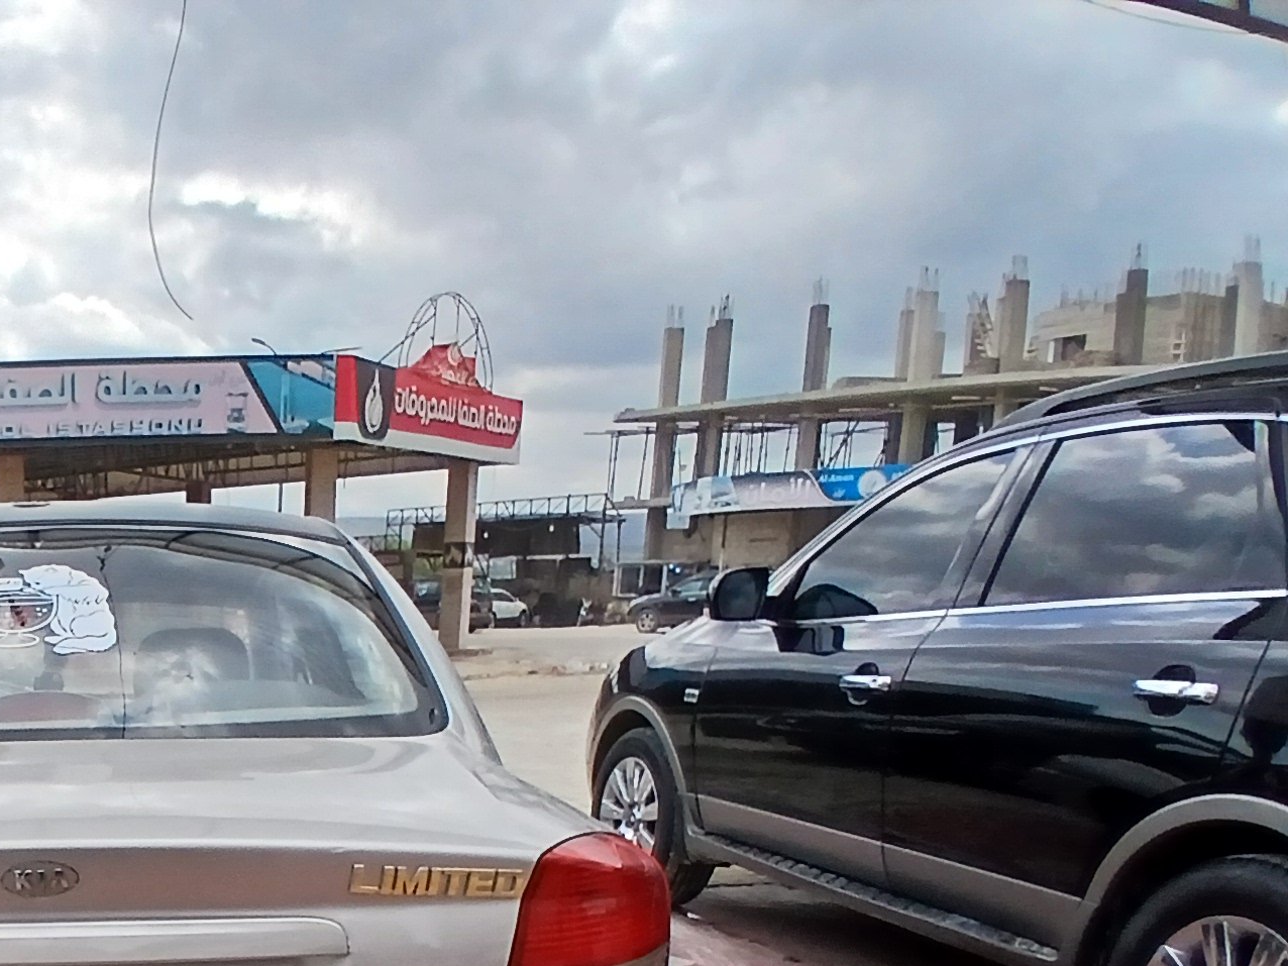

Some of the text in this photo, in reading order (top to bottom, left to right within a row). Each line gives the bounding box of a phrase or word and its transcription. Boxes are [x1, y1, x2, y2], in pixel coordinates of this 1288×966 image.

[95, 369, 202, 407] محطة
[394, 385, 517, 436] محطة الصفا للمحروقات
[348, 863, 524, 899] LIMITED
